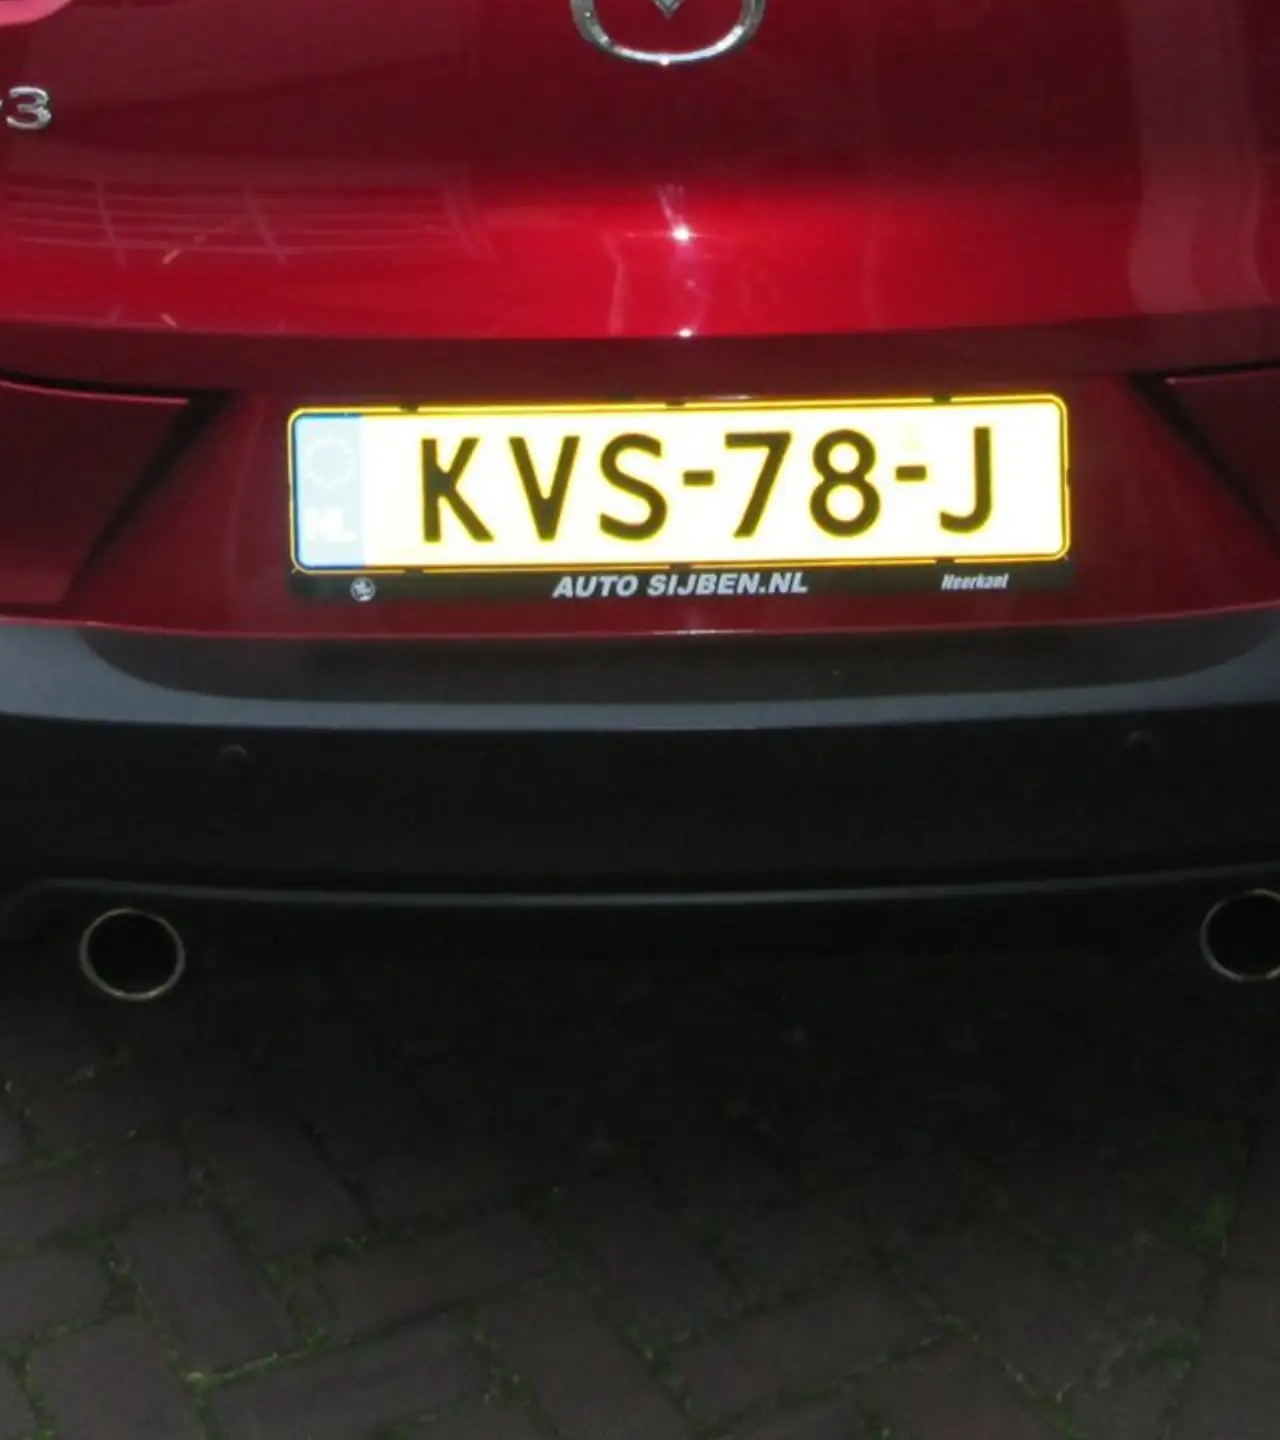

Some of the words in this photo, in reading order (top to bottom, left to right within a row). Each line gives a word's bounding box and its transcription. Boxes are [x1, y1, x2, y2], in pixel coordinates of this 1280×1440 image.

[420, 426, 993, 543] KVS-78-J
[552, 575, 639, 599] AUTO
[647, 572, 809, 597] SIJBEN.NL
